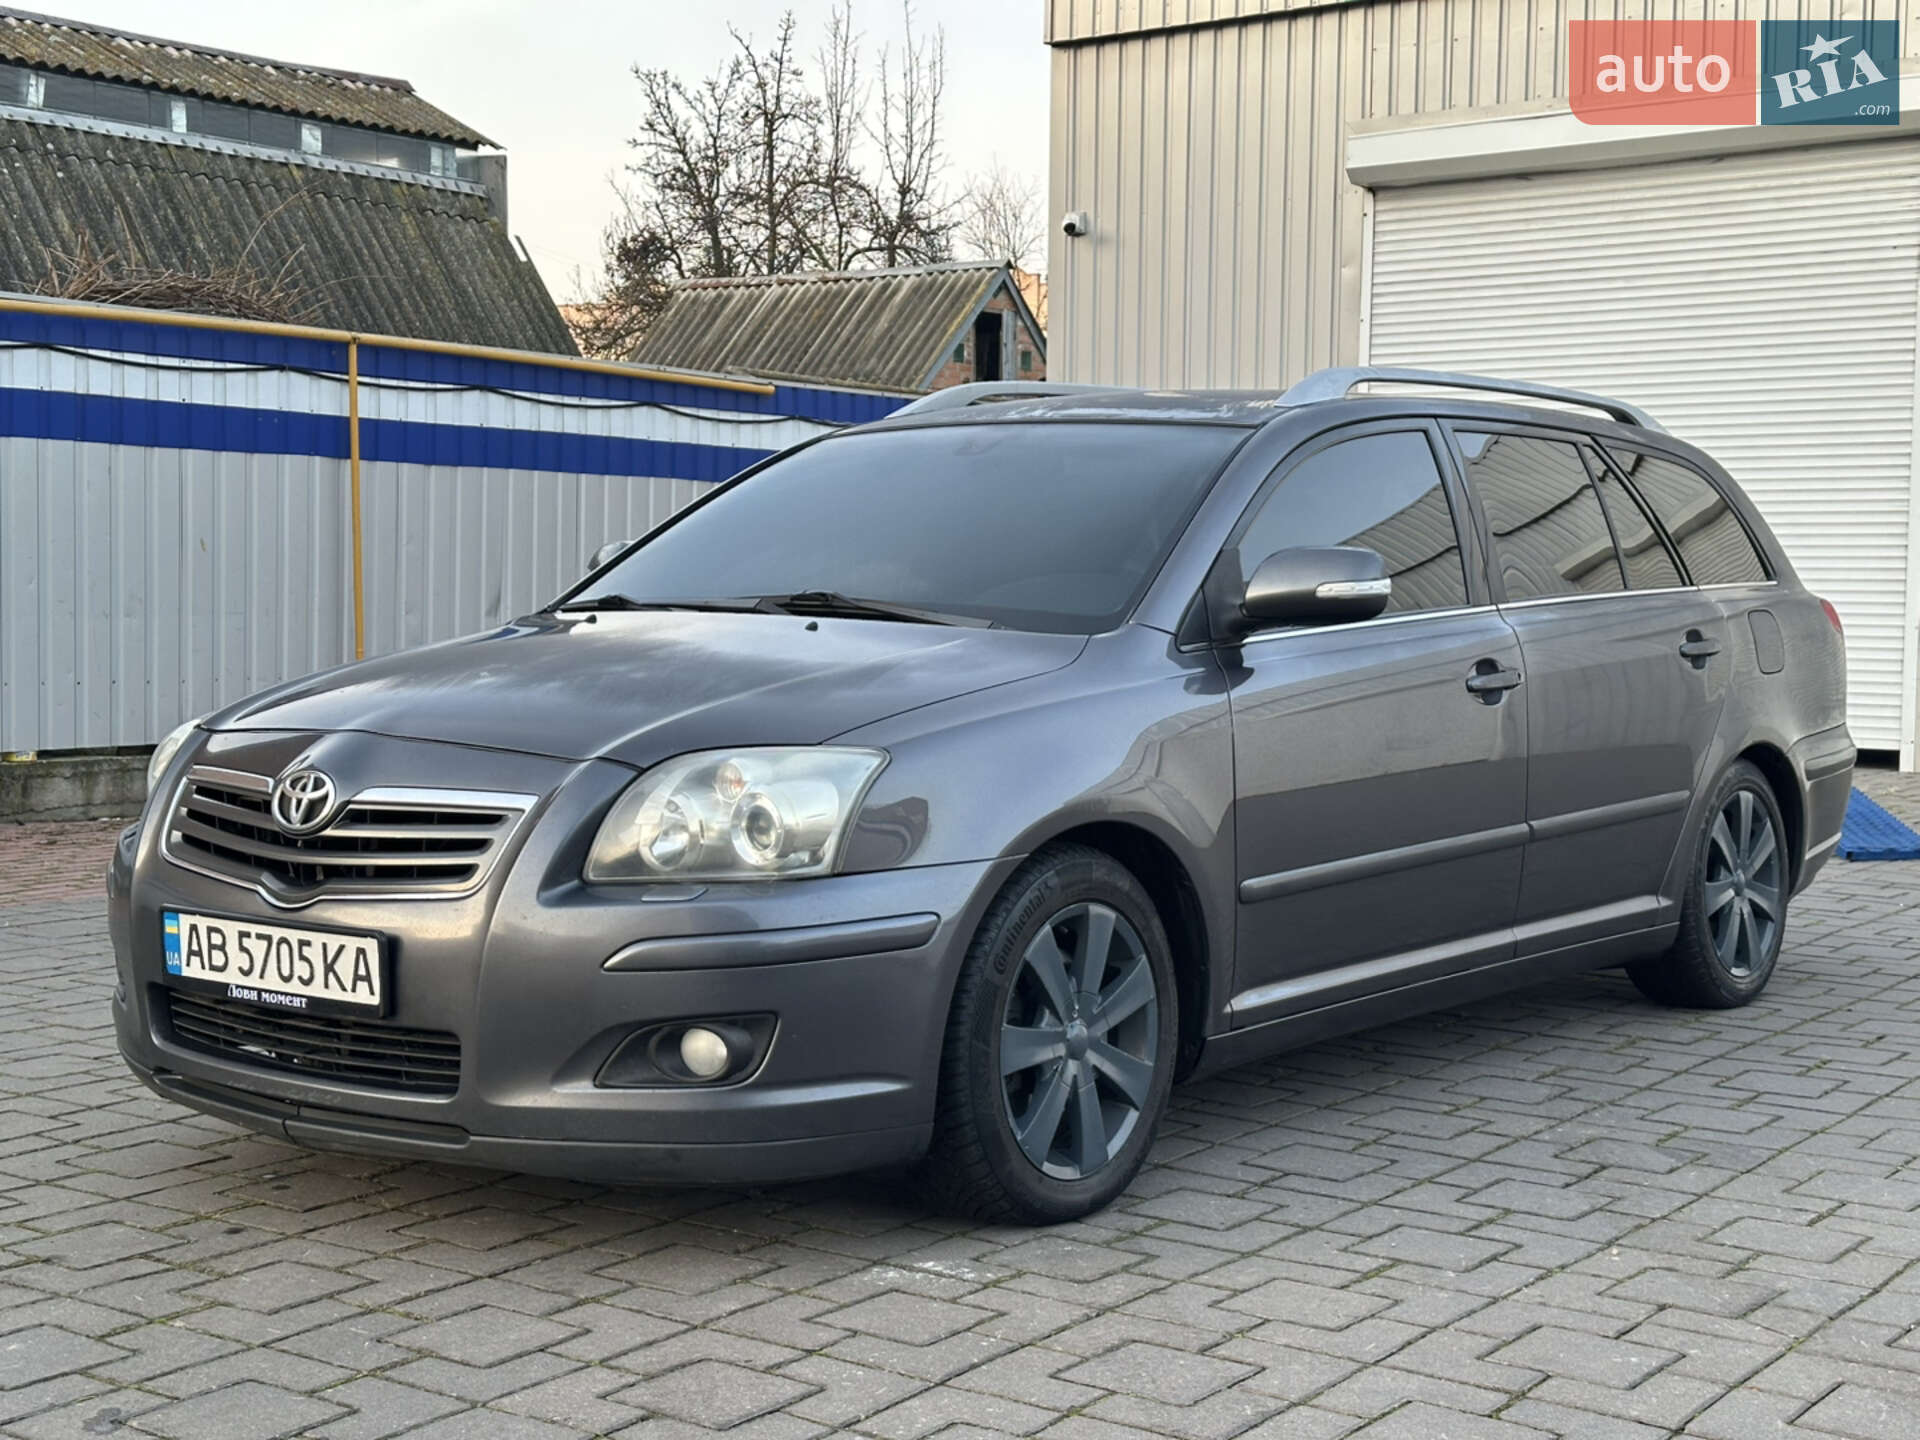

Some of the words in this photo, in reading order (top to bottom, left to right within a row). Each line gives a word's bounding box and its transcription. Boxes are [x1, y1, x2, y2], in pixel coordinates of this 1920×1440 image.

[993, 886, 1046, 975] Continental
[166, 951, 180, 966] UA
[185, 923, 229, 973] AB
[237, 930, 315, 986] 5705
[322, 942, 376, 996] KA
[261, 991, 308, 1008] момент
